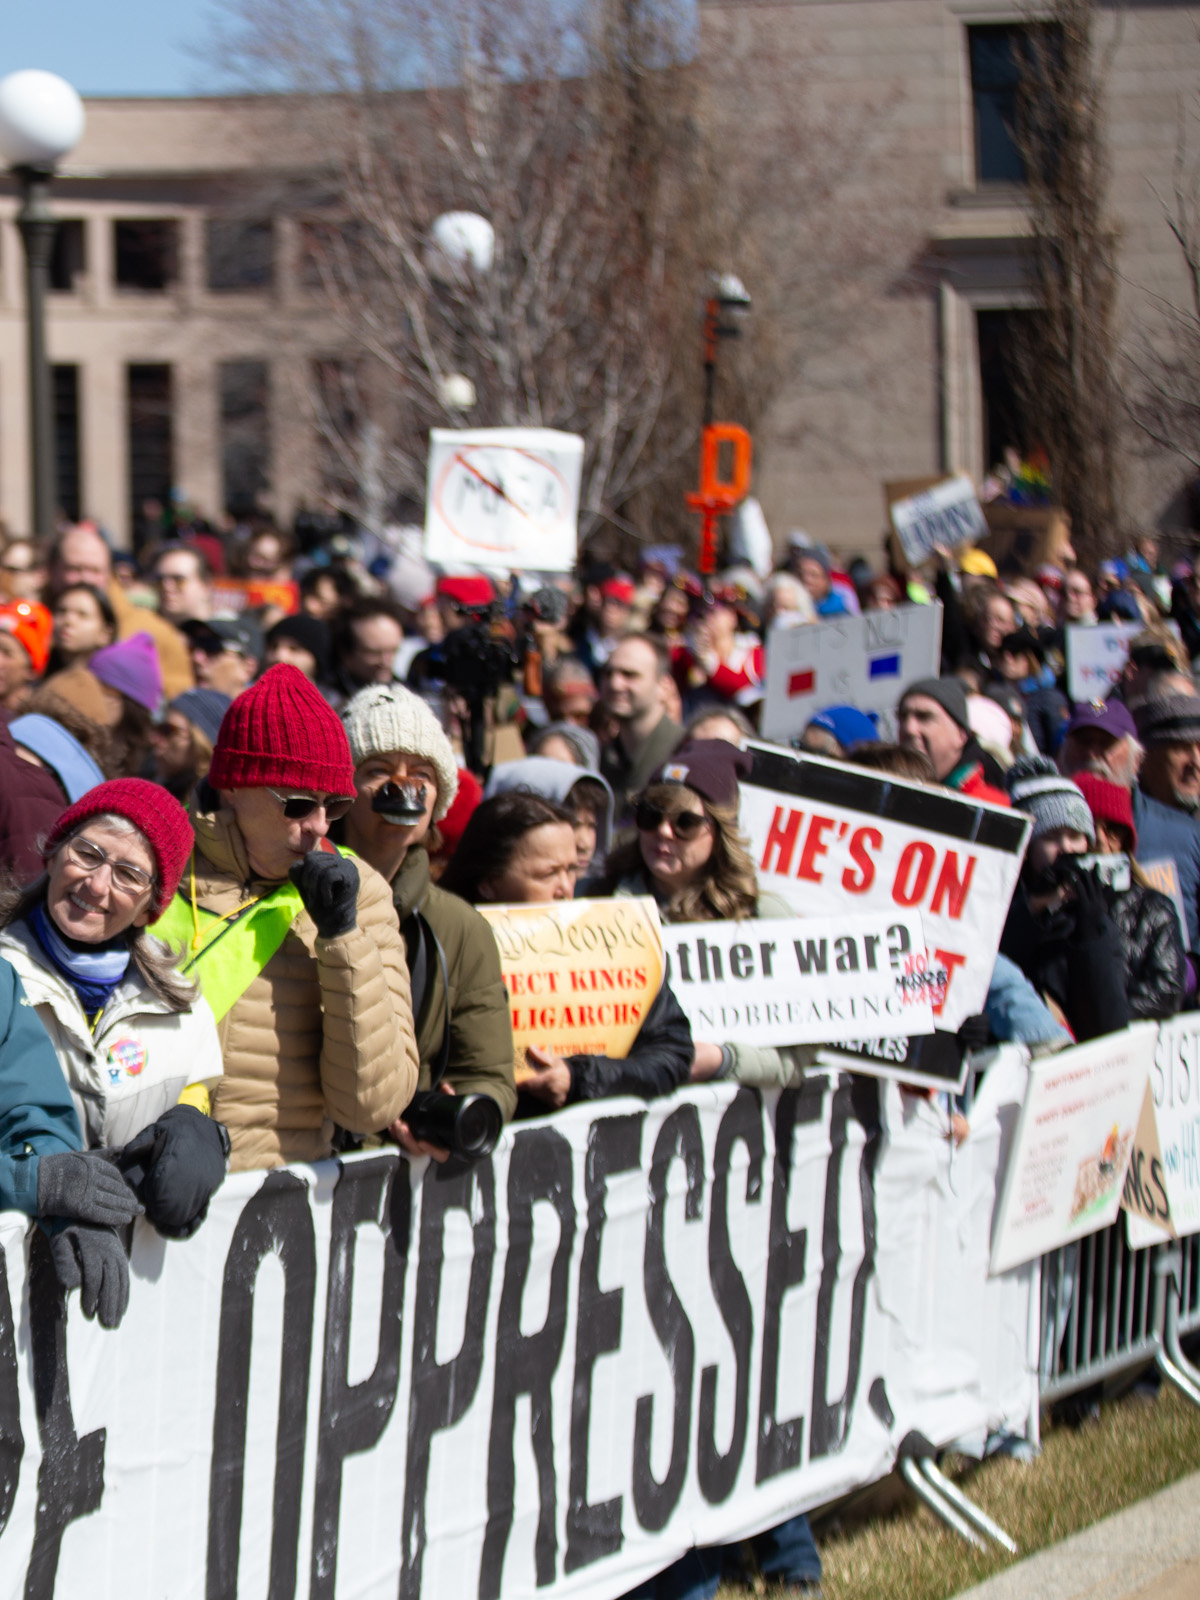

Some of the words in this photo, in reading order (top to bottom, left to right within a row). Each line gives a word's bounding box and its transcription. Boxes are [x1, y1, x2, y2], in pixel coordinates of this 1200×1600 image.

[760, 805, 884, 895] HE'S
[891, 840, 978, 920] ON
[542, 909, 647, 961] People
[666, 937, 776, 984] ther
[793, 924, 912, 976] war?
[570, 966, 648, 993] KINGS
[511, 1003, 642, 1031] LIGARCHS
[688, 995, 904, 1031] NDBREAKING
